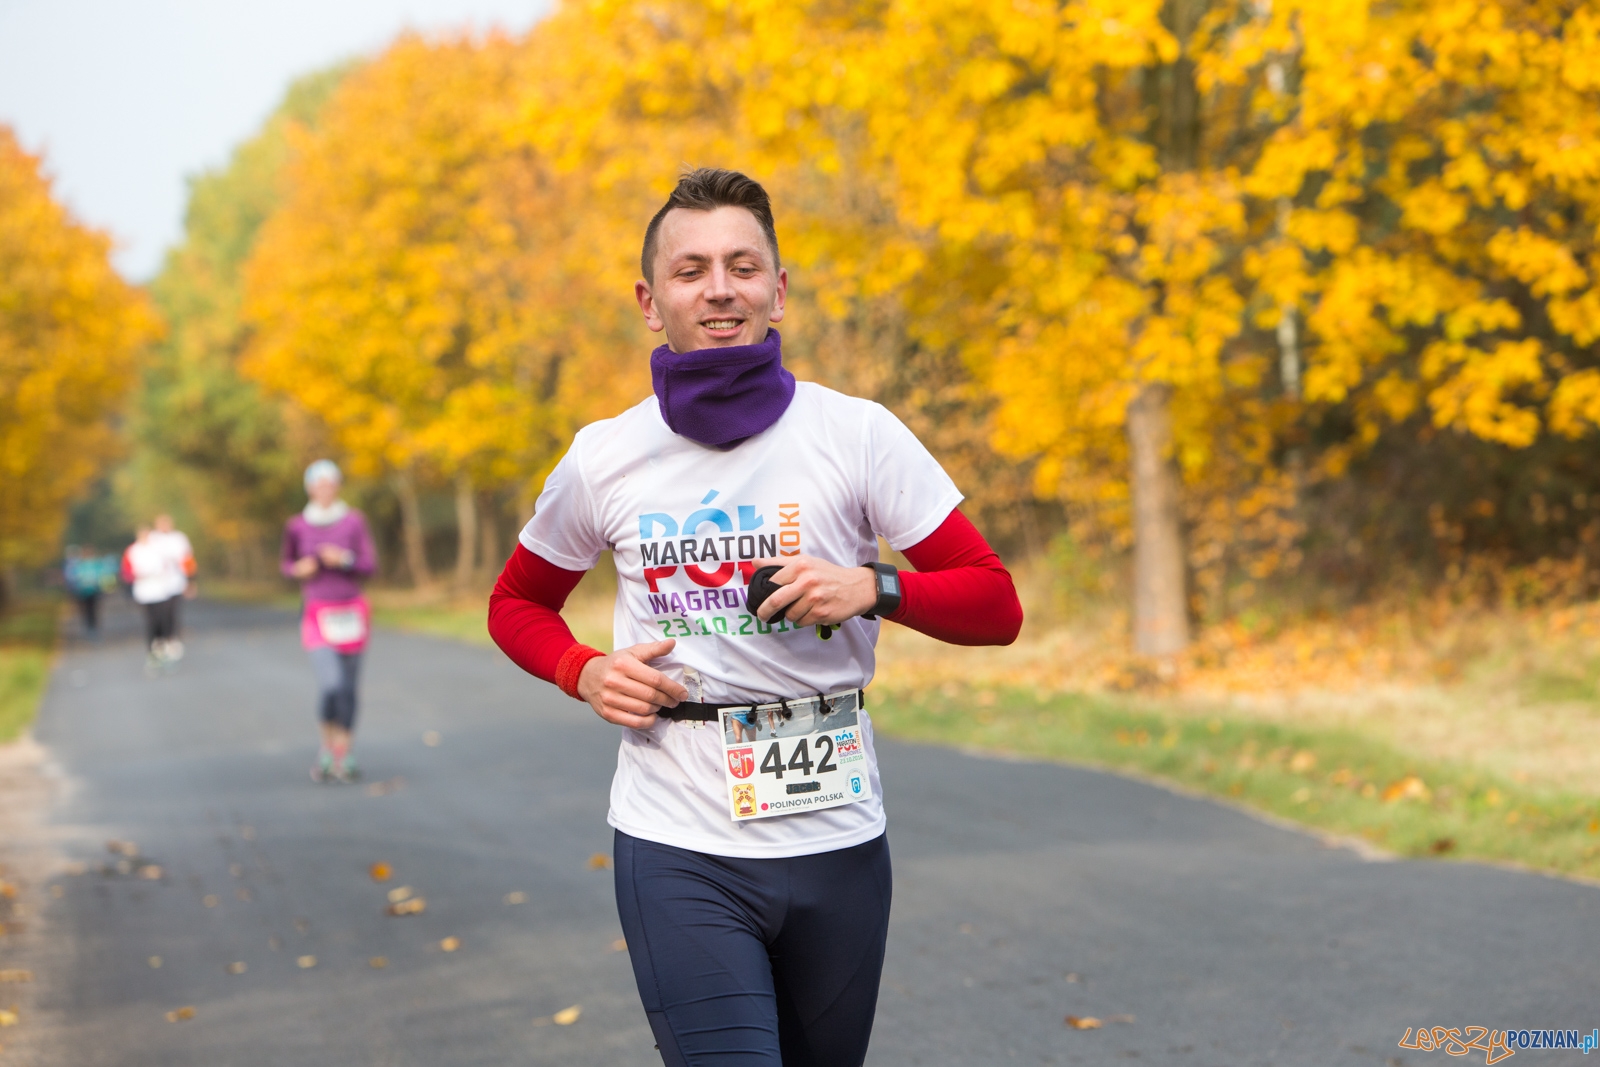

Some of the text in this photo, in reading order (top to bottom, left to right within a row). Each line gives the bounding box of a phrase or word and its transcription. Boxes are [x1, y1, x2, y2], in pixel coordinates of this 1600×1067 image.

[640, 534, 776, 567] MARATON
[760, 735, 837, 780] 442
[770, 798, 813, 810] POLINOVA
[814, 792, 844, 804] POLSKA
